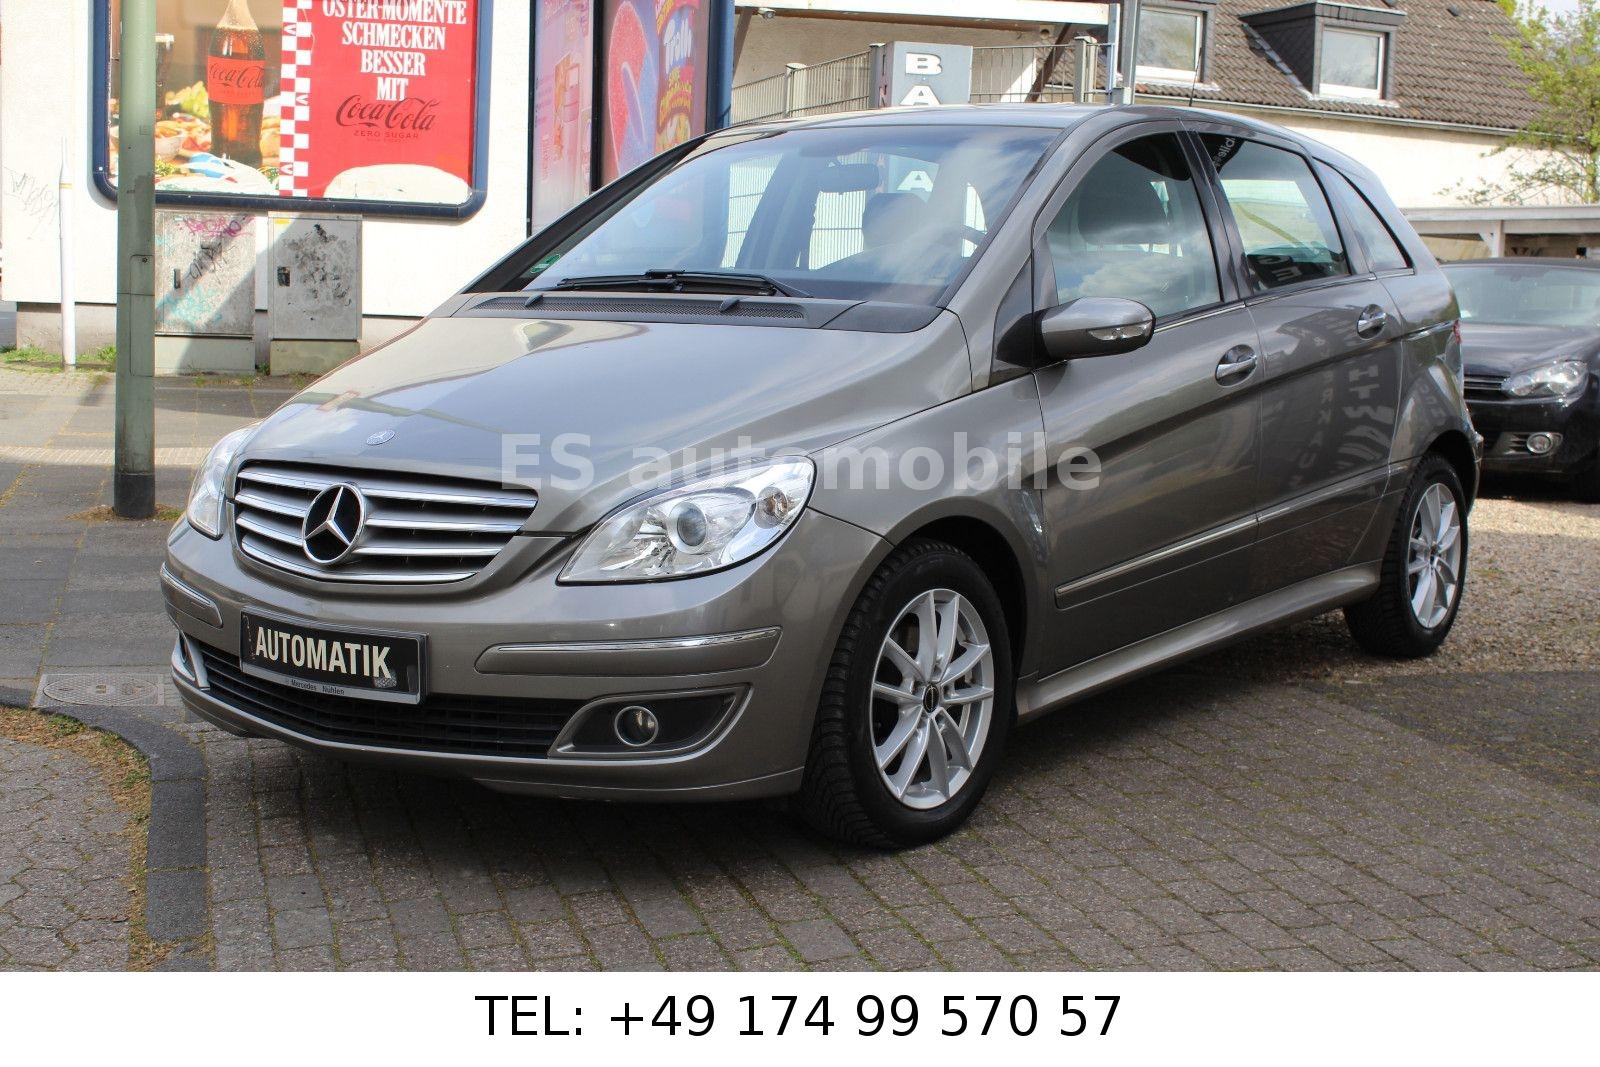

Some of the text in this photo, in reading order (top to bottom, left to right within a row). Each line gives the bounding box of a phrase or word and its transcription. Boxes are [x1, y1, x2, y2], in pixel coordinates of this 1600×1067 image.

[322, 0, 467, 25] OSTER-MOMENTE
[342, 21, 446, 50] SCHMECKEN
[360, 49, 426, 76] BESSER
[376, 77, 409, 101] MIT
[353, 130, 419, 139] ZERO SUGAR
[256, 626, 392, 680] AUTOMATIK
